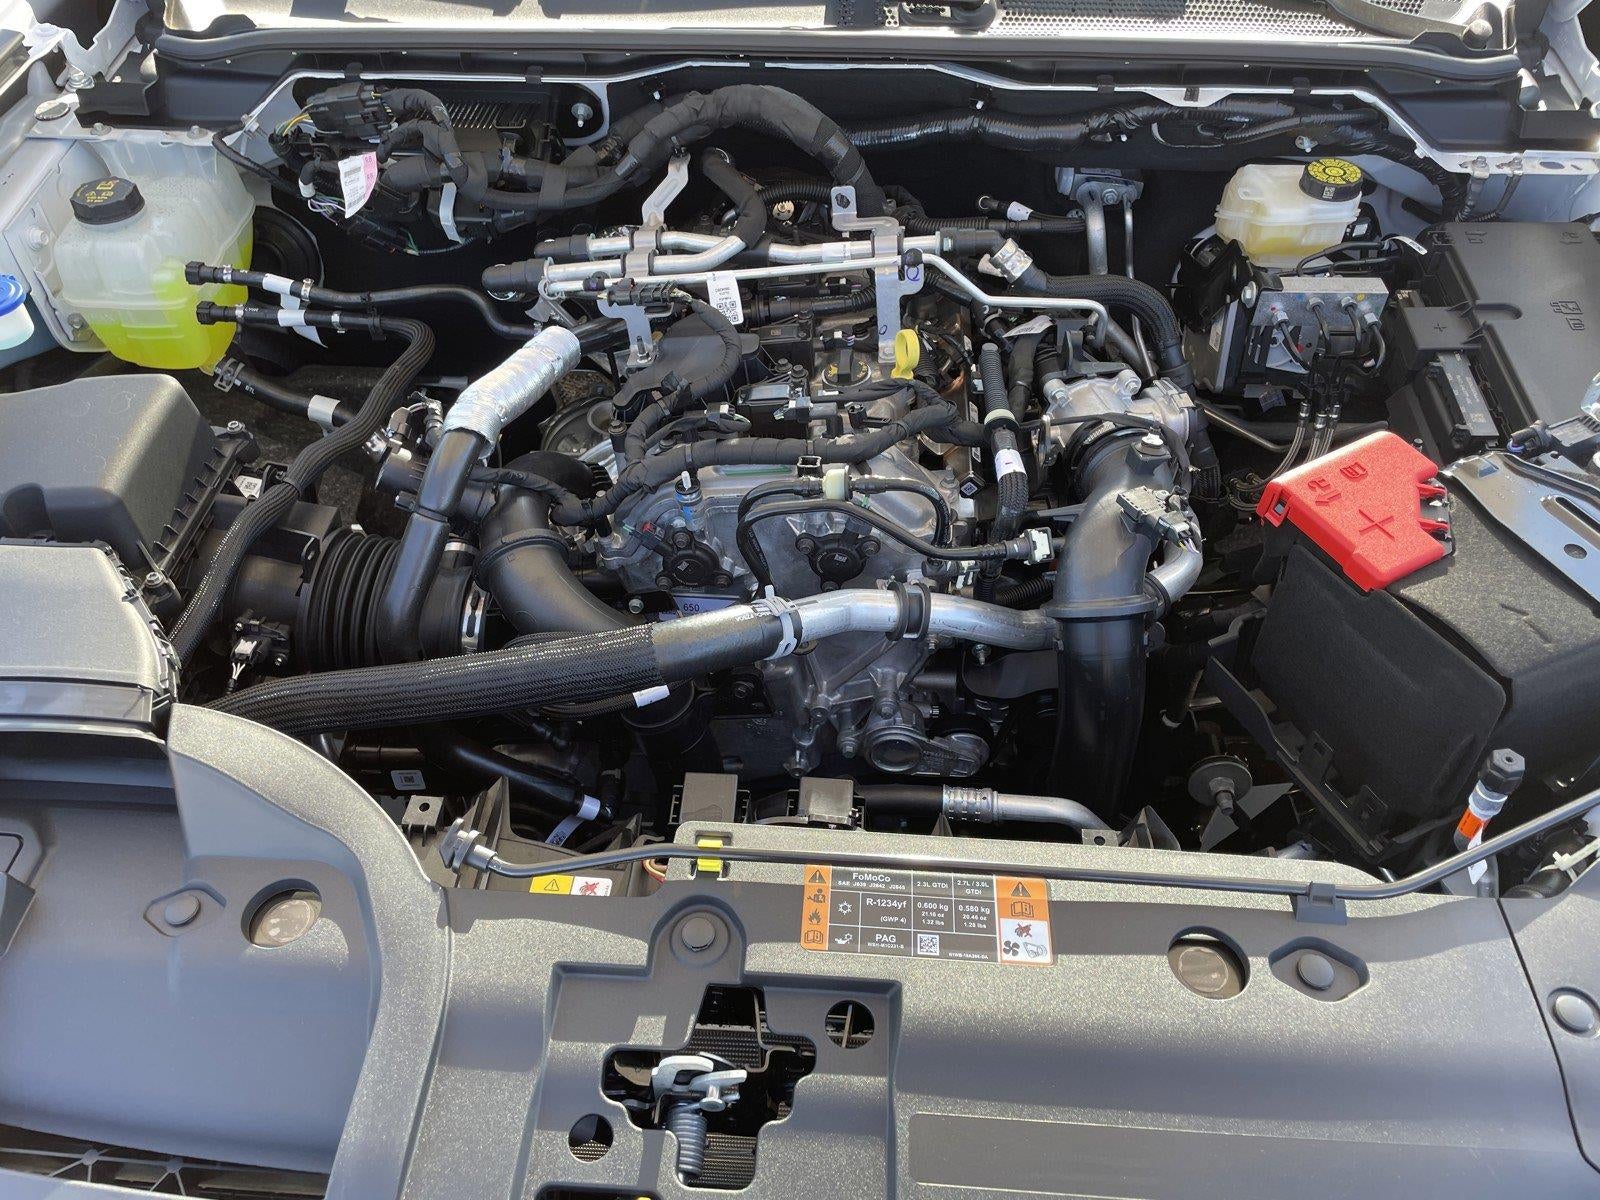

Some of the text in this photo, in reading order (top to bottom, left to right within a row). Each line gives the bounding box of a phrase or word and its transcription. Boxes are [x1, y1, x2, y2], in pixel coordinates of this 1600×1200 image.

[683, 603, 700, 612] 650
[852, 872, 891, 883] FoMoCo
[866, 898, 907, 909] R-1234yf
[917, 901, 949, 912] 0.600 kg
[958, 904, 991, 915] 0.580 kg
[880, 915, 899, 923] (GWP
[875, 933, 897, 943] PAG
